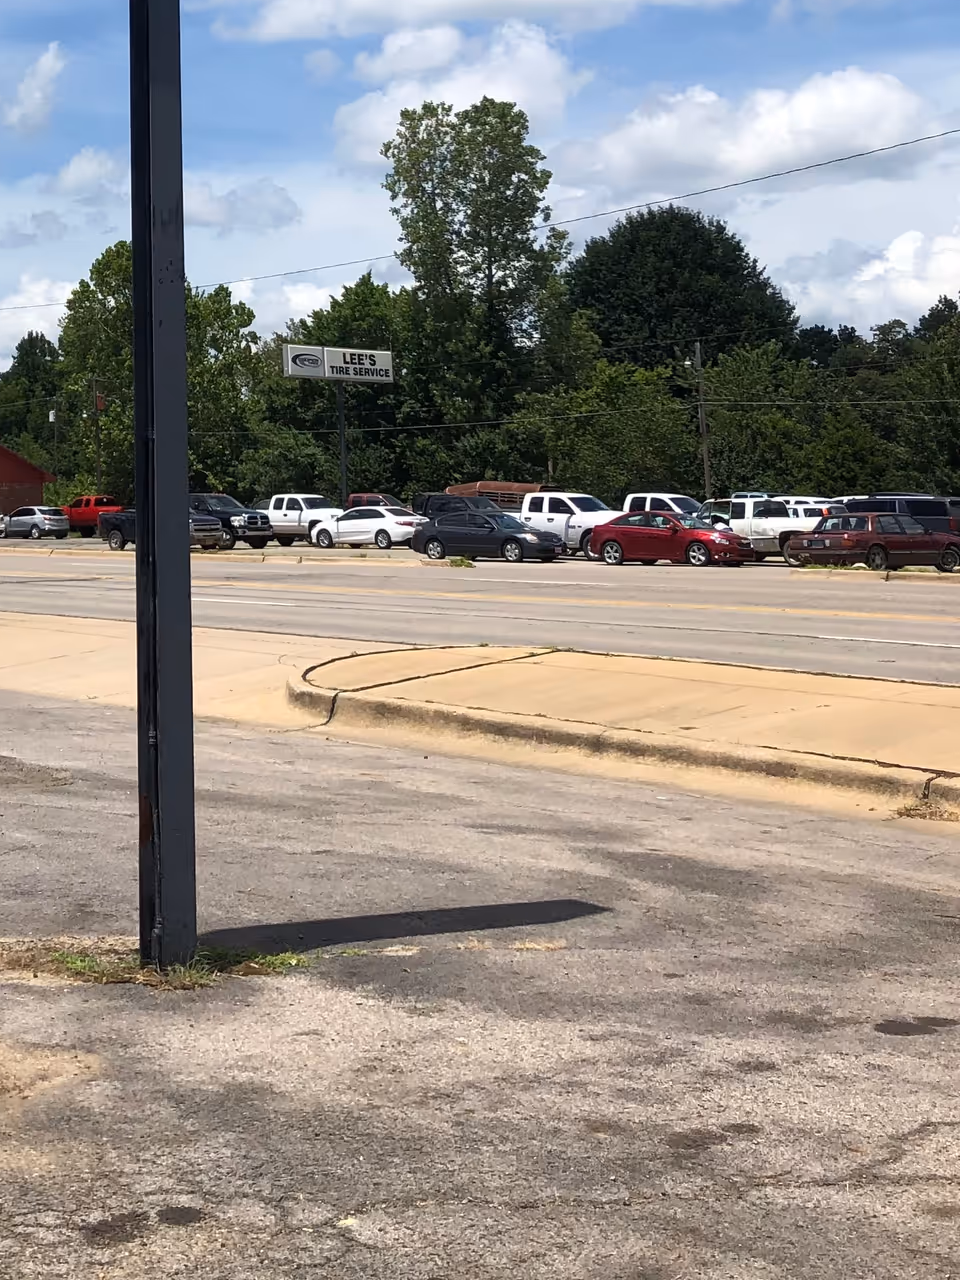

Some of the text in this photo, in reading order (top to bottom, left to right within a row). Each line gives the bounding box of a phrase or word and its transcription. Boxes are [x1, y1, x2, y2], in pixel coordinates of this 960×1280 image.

[342, 352, 376, 367] LEE'S
[330, 365, 390, 378] TIRE SERVICE
